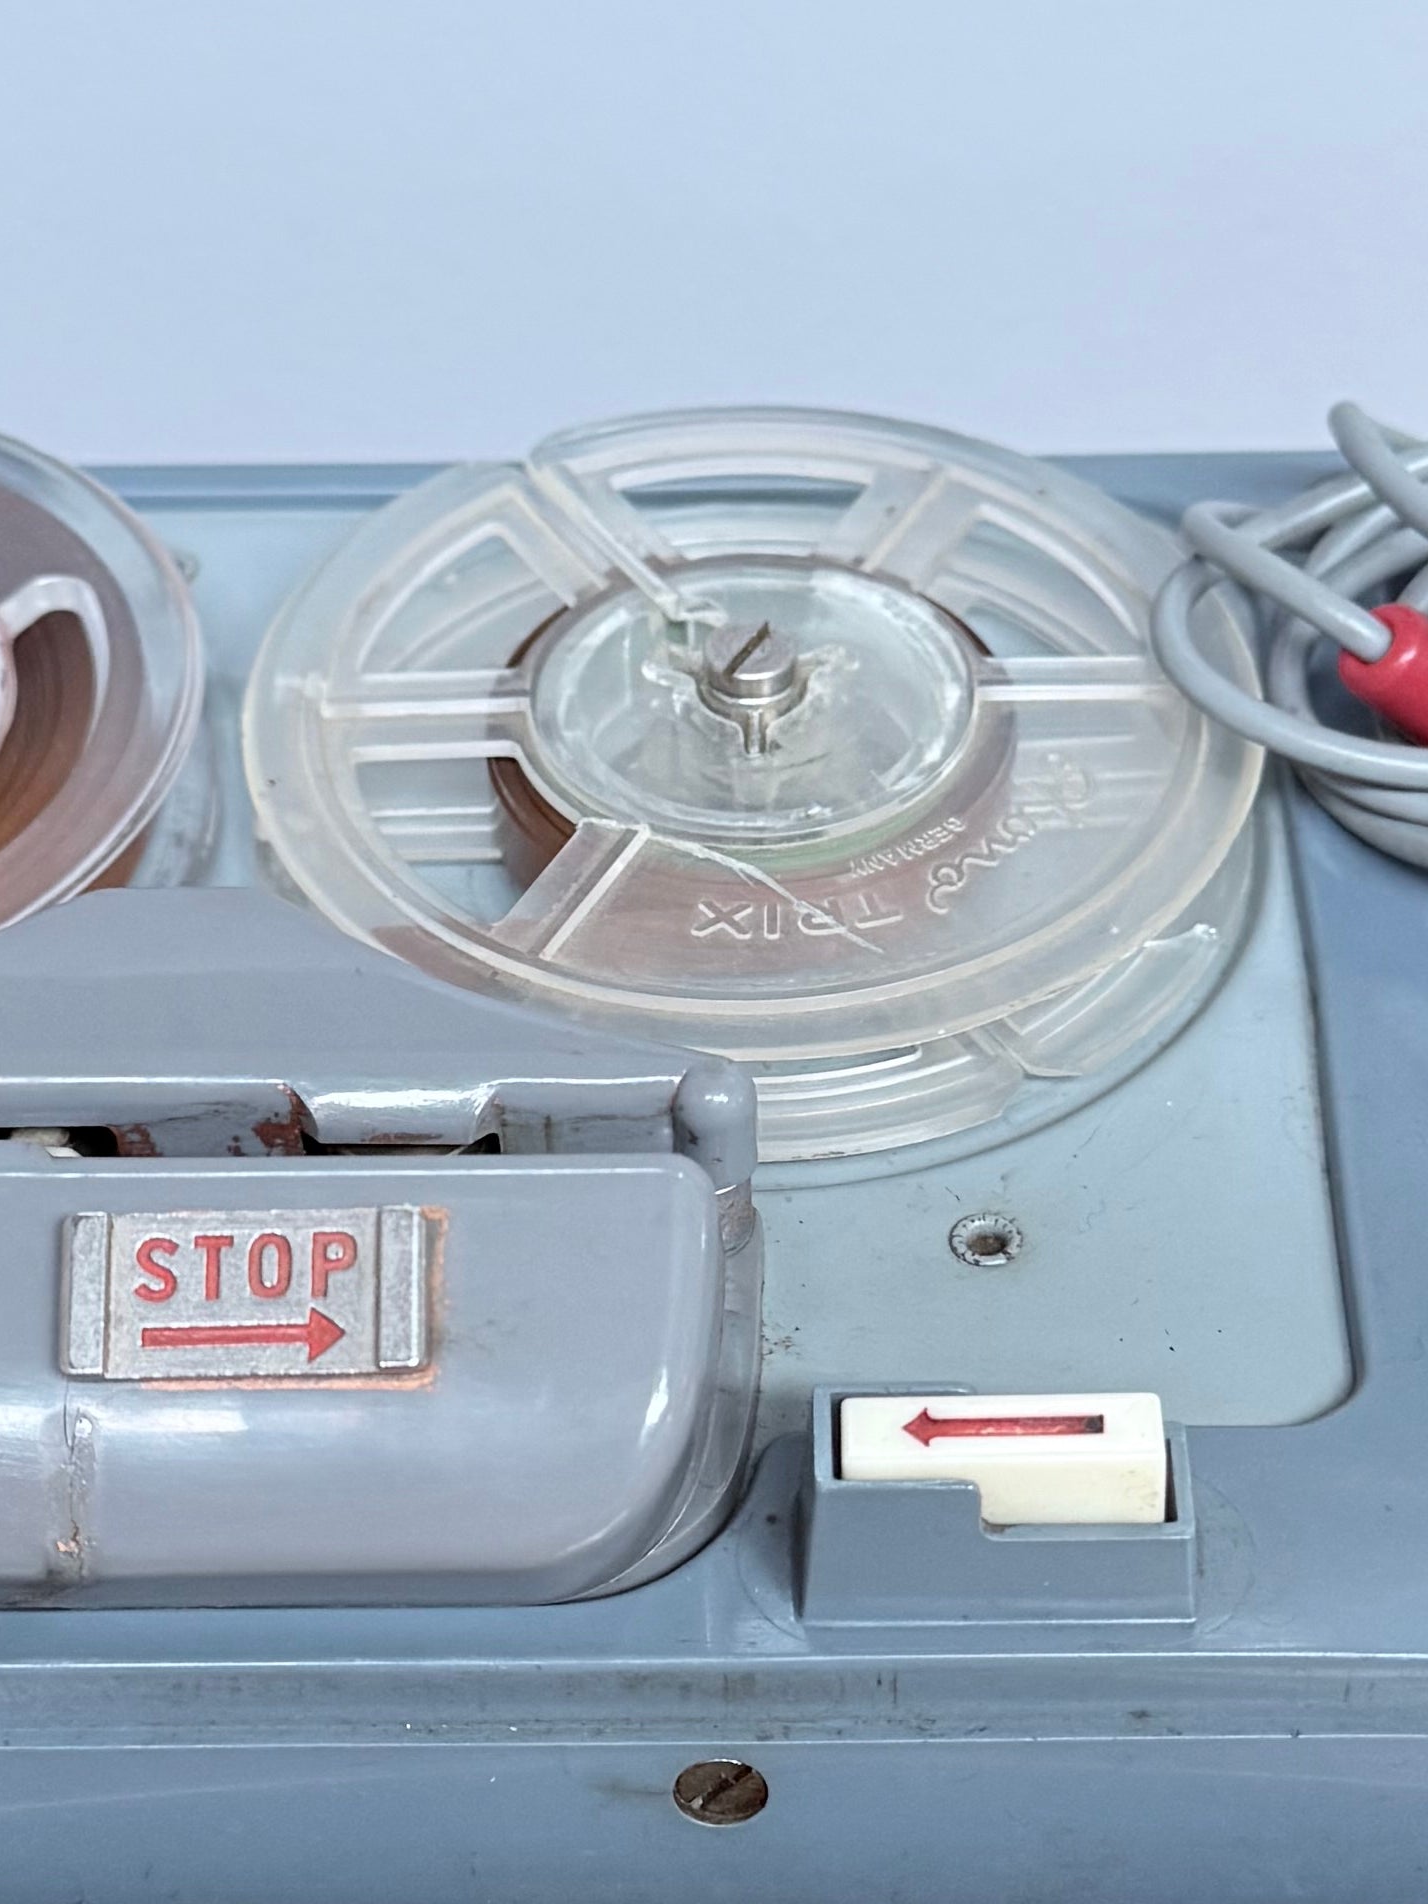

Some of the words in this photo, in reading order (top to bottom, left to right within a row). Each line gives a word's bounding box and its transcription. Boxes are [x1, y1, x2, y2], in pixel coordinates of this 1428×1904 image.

[848, 816, 967, 880] GERMANY
[689, 893, 903, 941] TRIX
[133, 1231, 359, 1303] STOP
